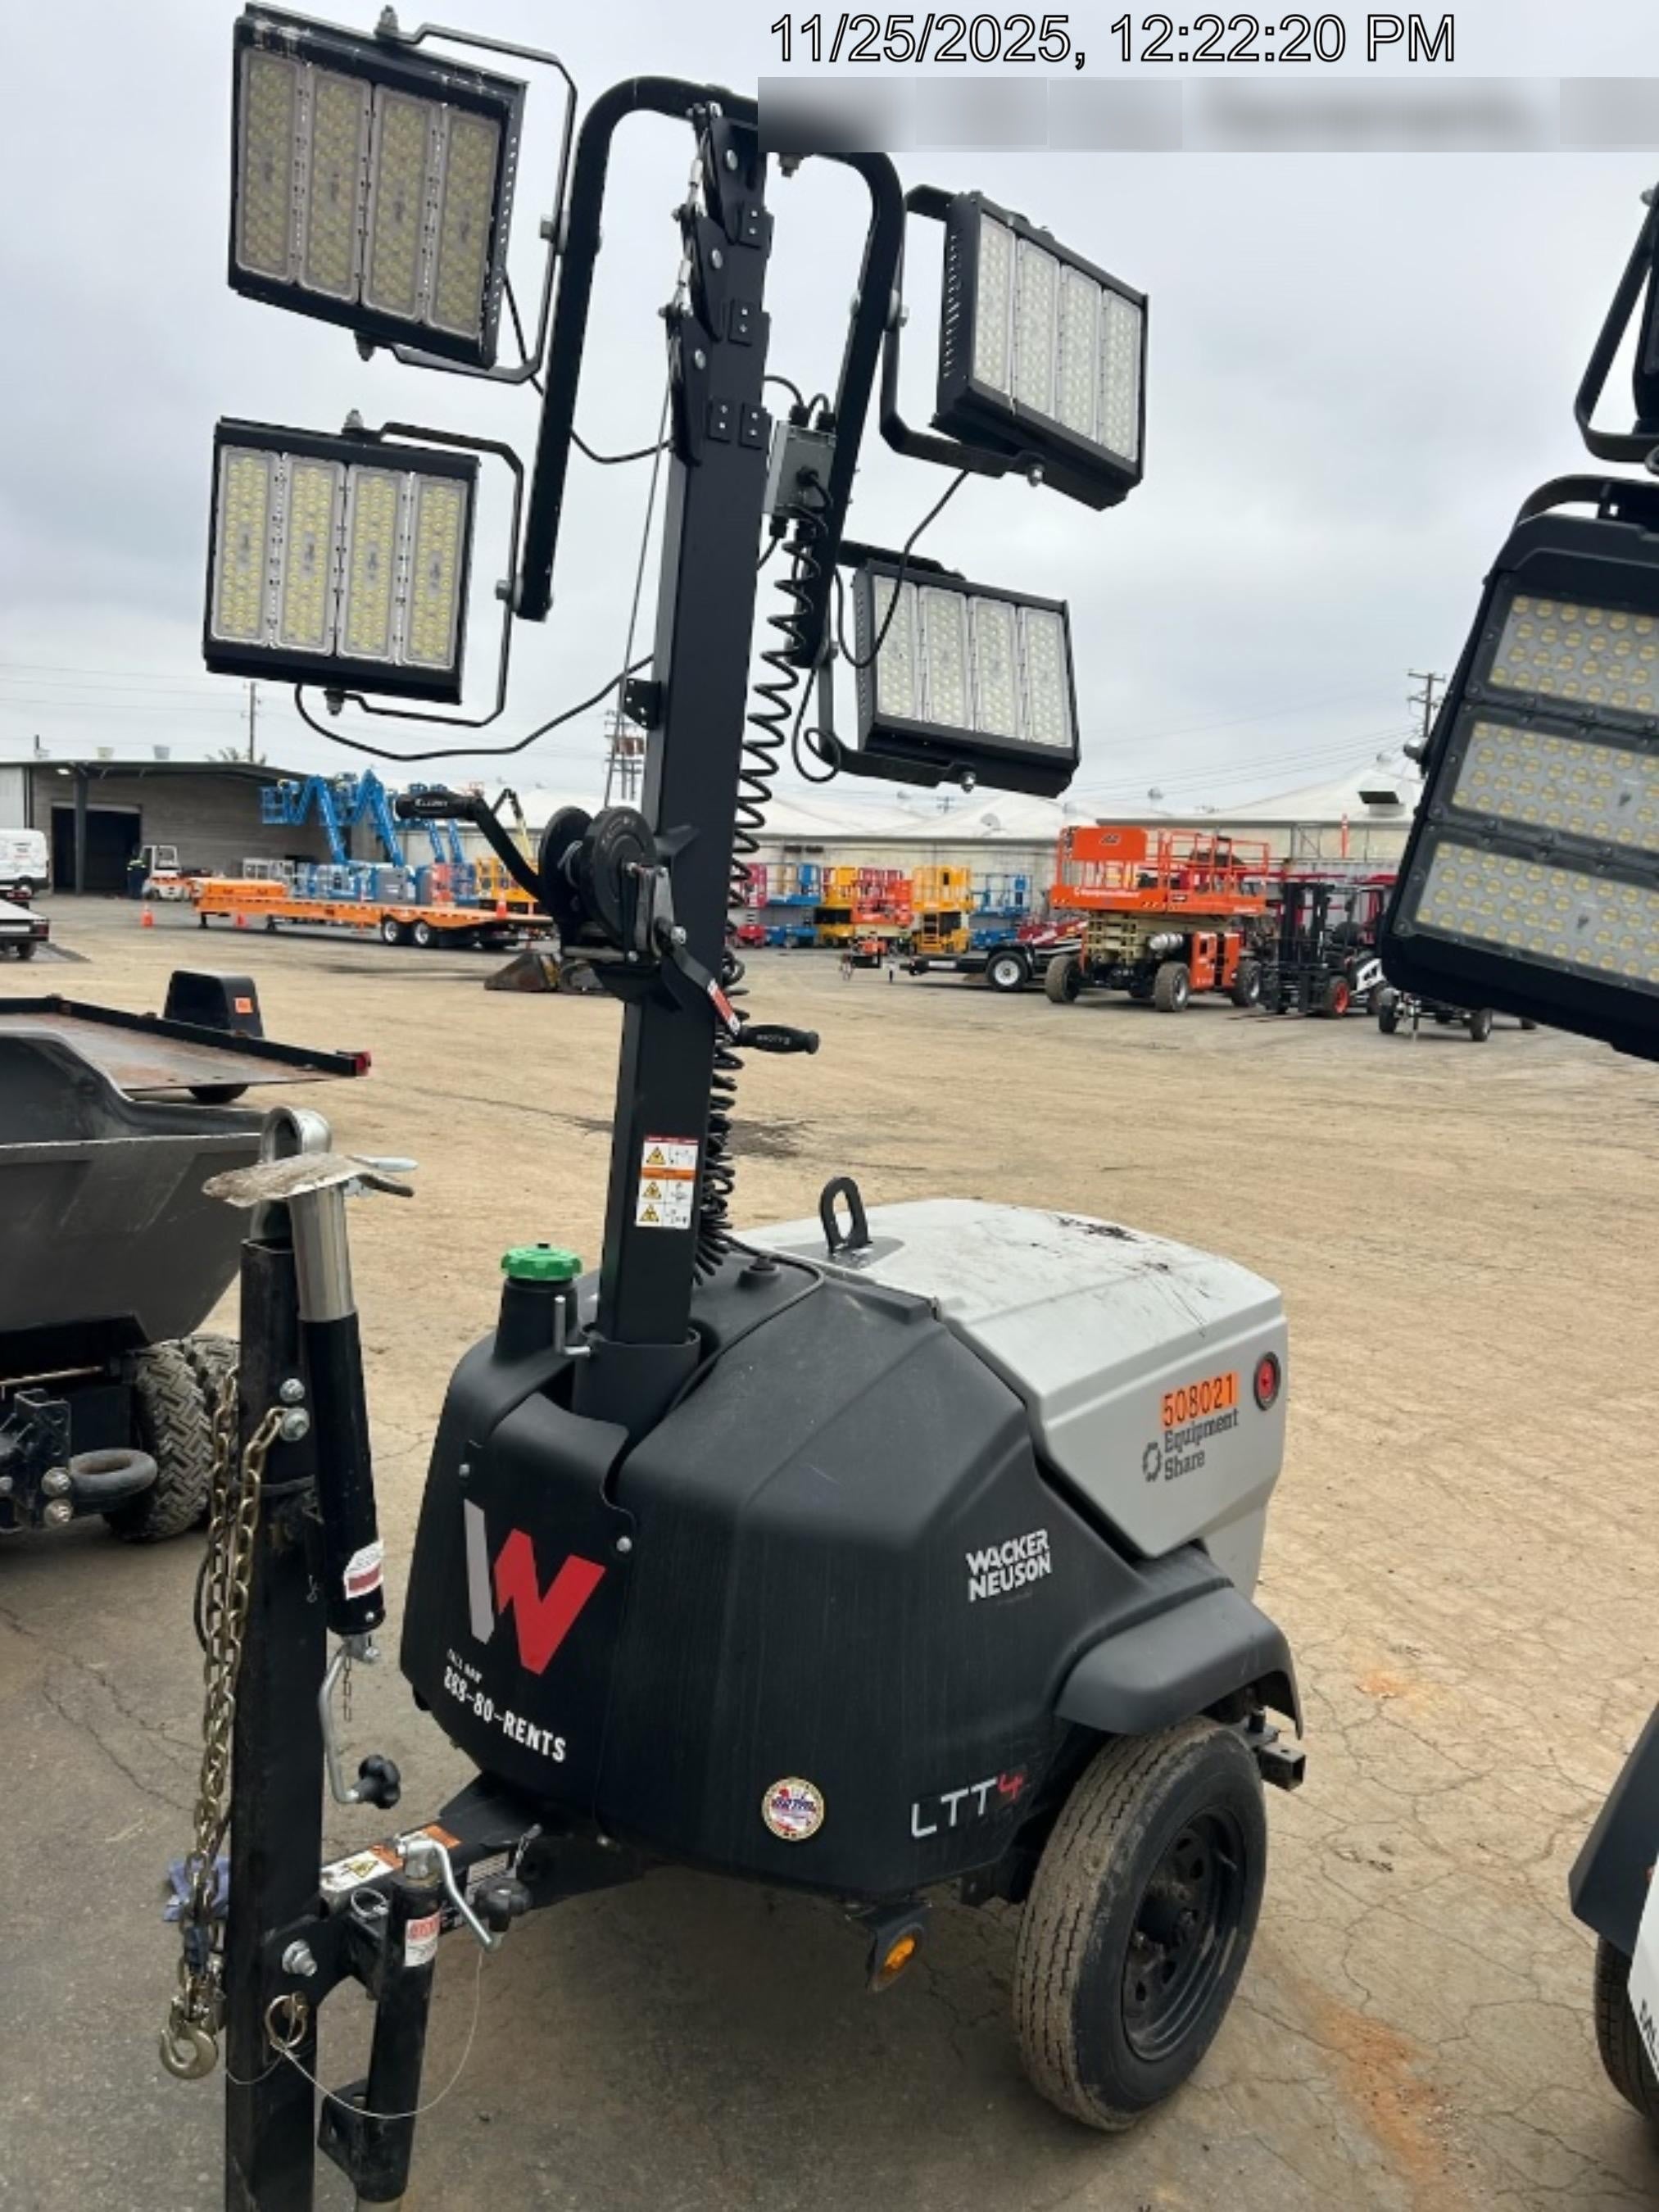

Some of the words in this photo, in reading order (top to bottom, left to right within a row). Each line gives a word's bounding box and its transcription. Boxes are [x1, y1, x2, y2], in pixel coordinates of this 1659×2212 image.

[1163, 1374, 1233, 1426] 508021
[1164, 1408, 1239, 1453] Equipment
[1164, 1450, 1205, 1480] Share
[965, 1529, 1049, 1575] WACKER
[968, 1551, 1052, 1602] NEUSON
